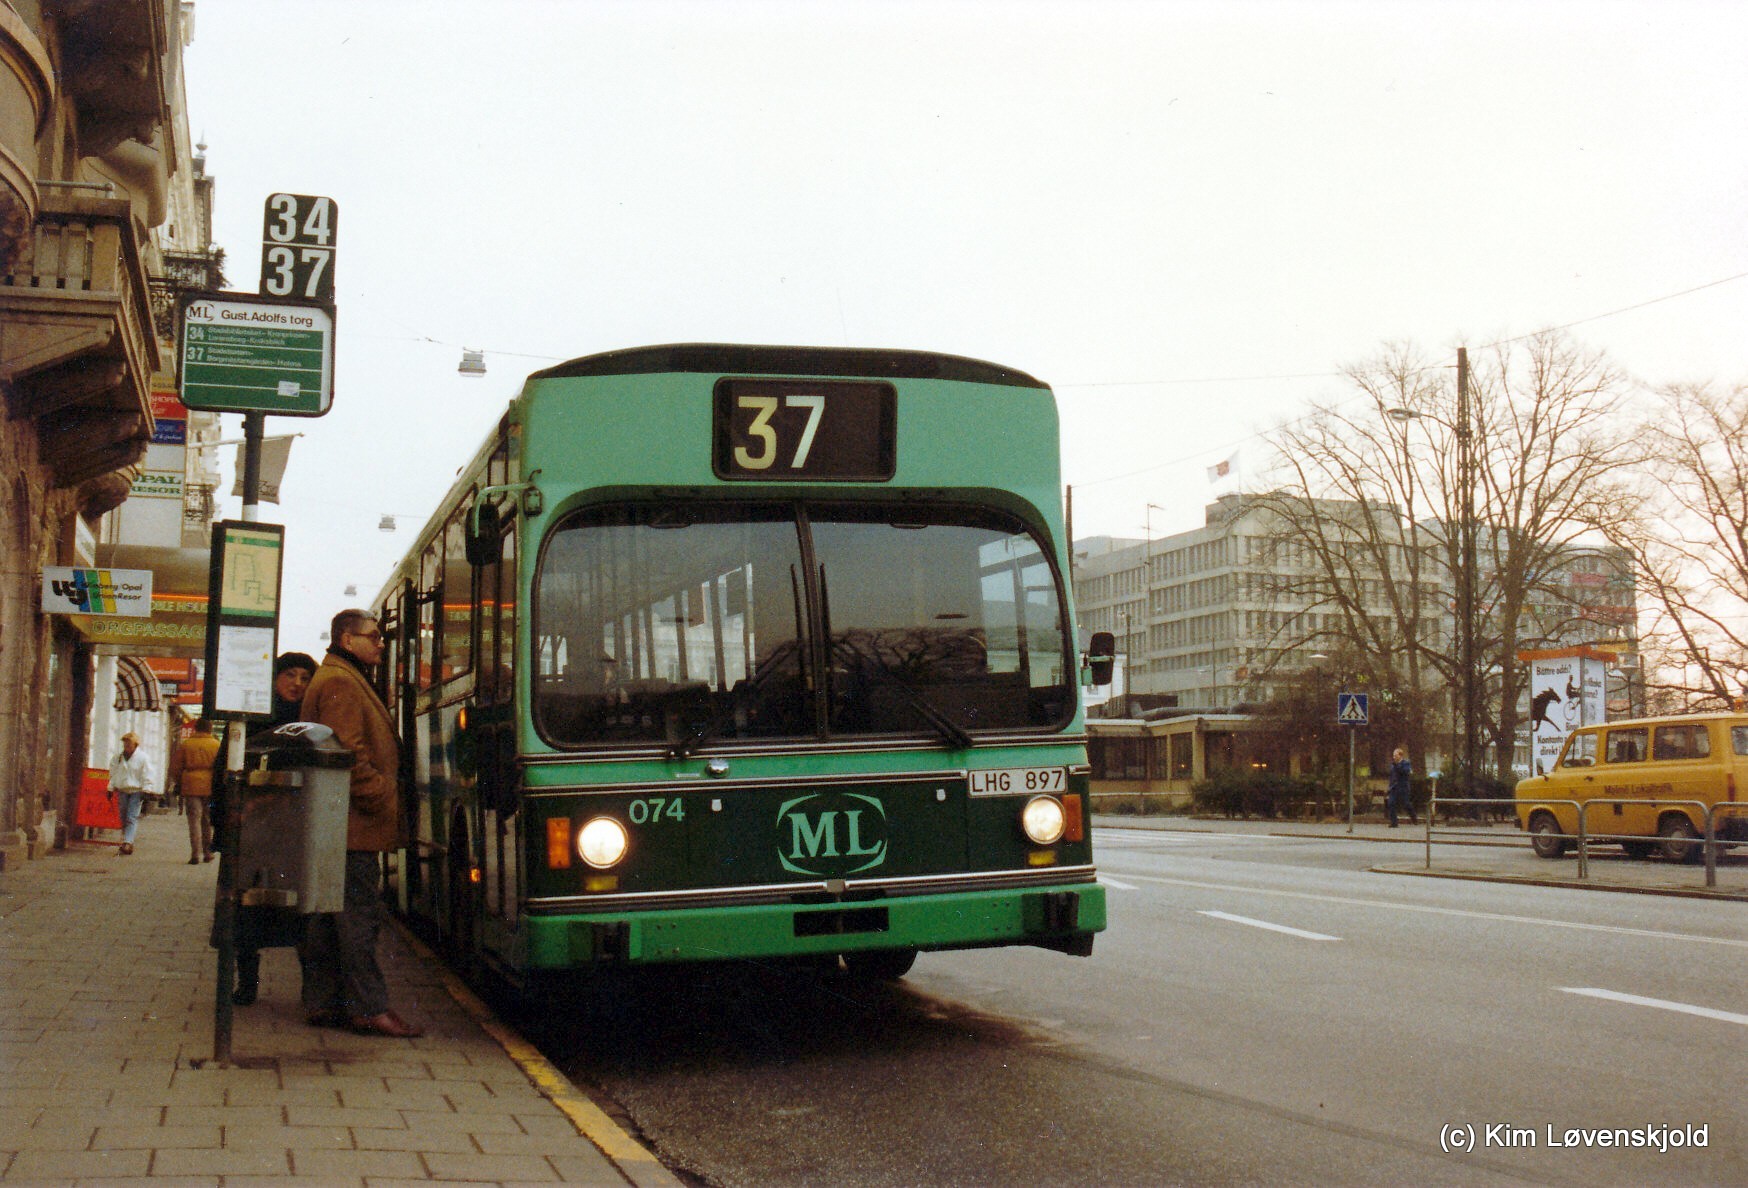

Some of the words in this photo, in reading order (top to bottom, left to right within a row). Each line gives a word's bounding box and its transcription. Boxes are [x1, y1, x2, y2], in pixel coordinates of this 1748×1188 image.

[270, 194, 331, 245] 34
[267, 247, 330, 297] 37
[188, 305, 214, 320] ML
[289, 314, 313, 327] torg
[189, 326, 204, 340] 34
[187, 346, 204, 360] 37
[734, 395, 825, 469] 37
[972, 773, 1010, 792] LHG
[1026, 770, 1063, 790] 897
[629, 797, 685, 824] 074
[787, 810, 883, 859] ML
